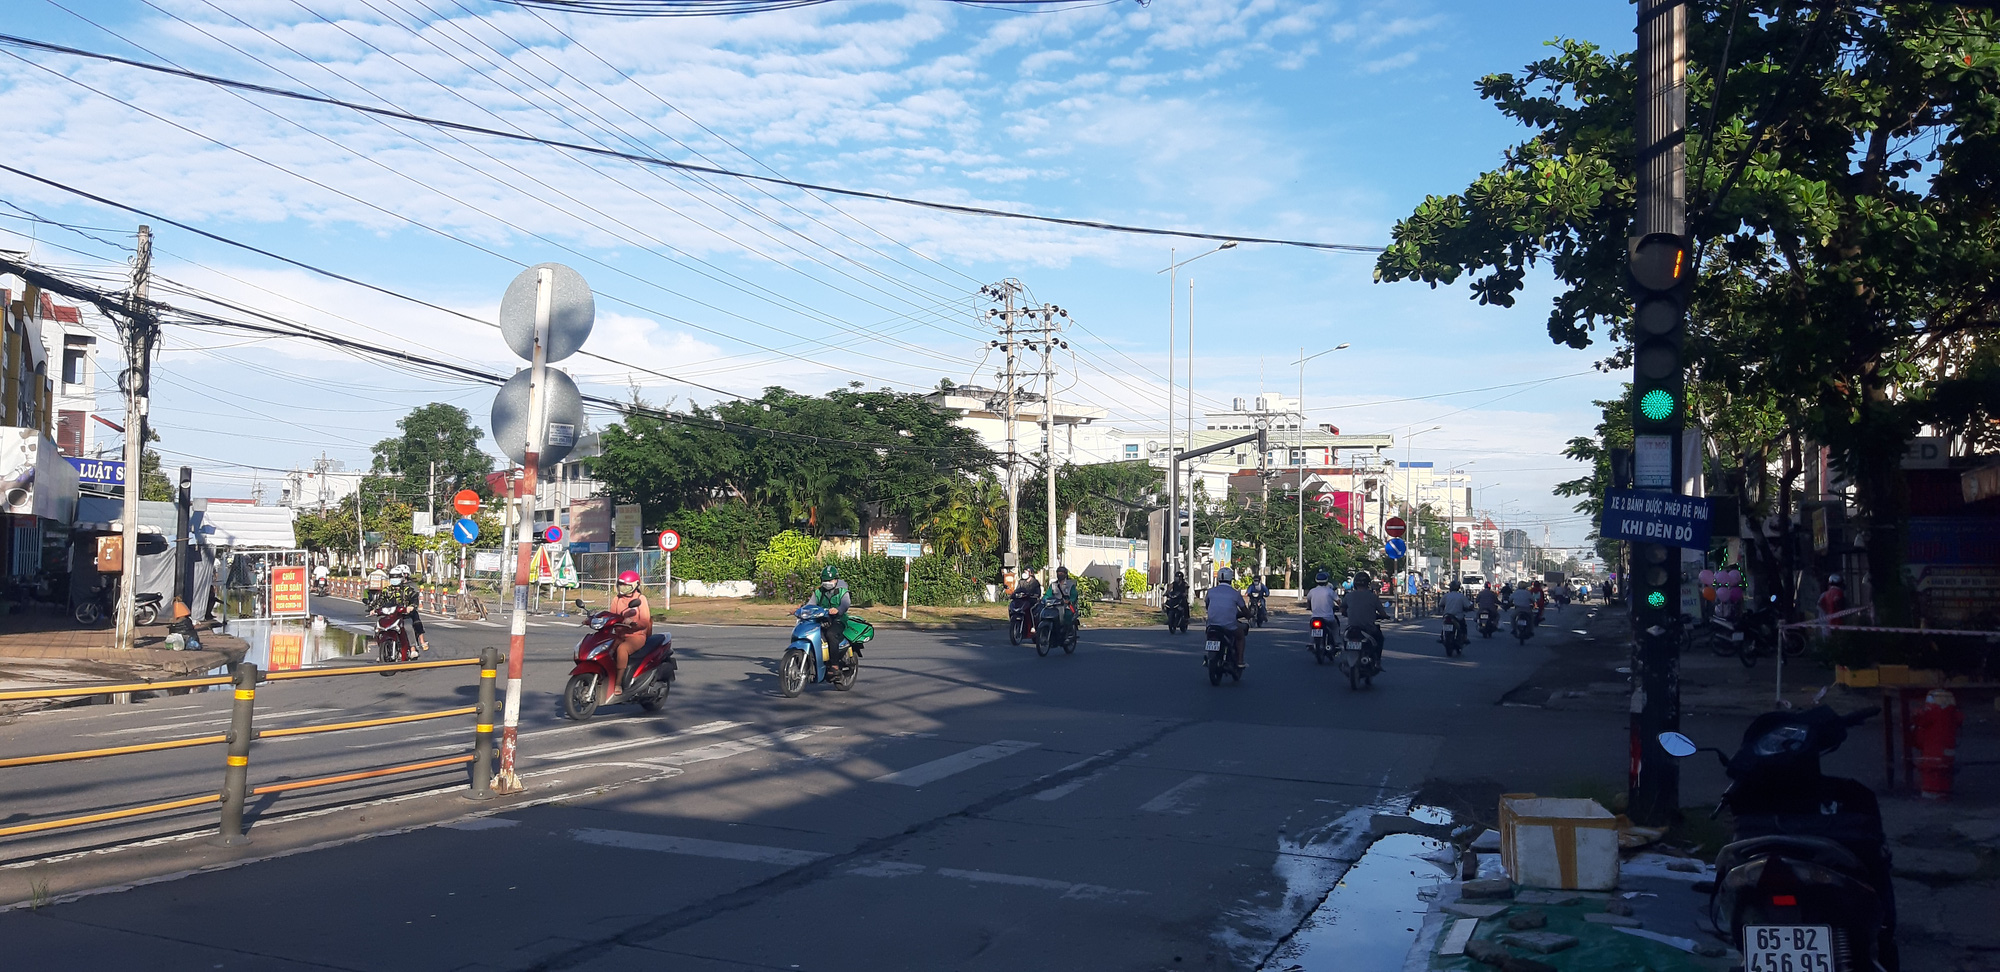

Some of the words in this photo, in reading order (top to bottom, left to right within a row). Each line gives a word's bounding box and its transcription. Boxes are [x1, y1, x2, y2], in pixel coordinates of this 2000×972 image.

[80, 461, 113, 482] LUẬT
[1611, 496, 1620, 510] XE
[1621, 497, 1626, 510] 2
[1627, 495, 1644, 512] BÁNH
[1646, 497, 1662, 518] ĐƯỢC
[1664, 499, 1681, 516] PHÉP
[1682, 502, 1692, 518] RẼ
[1694, 502, 1709, 520] PHẢI
[1621, 520, 1644, 536] KHI
[1646, 520, 1672, 538] ĐÈN
[1675, 522, 1693, 542] ĐỎ
[282, 570, 295, 580] CHỐT
[276, 581, 288, 592] KIỂM
[289, 582, 302, 591] SOÁT
[1757, 928, 1818, 950] 65-B2
